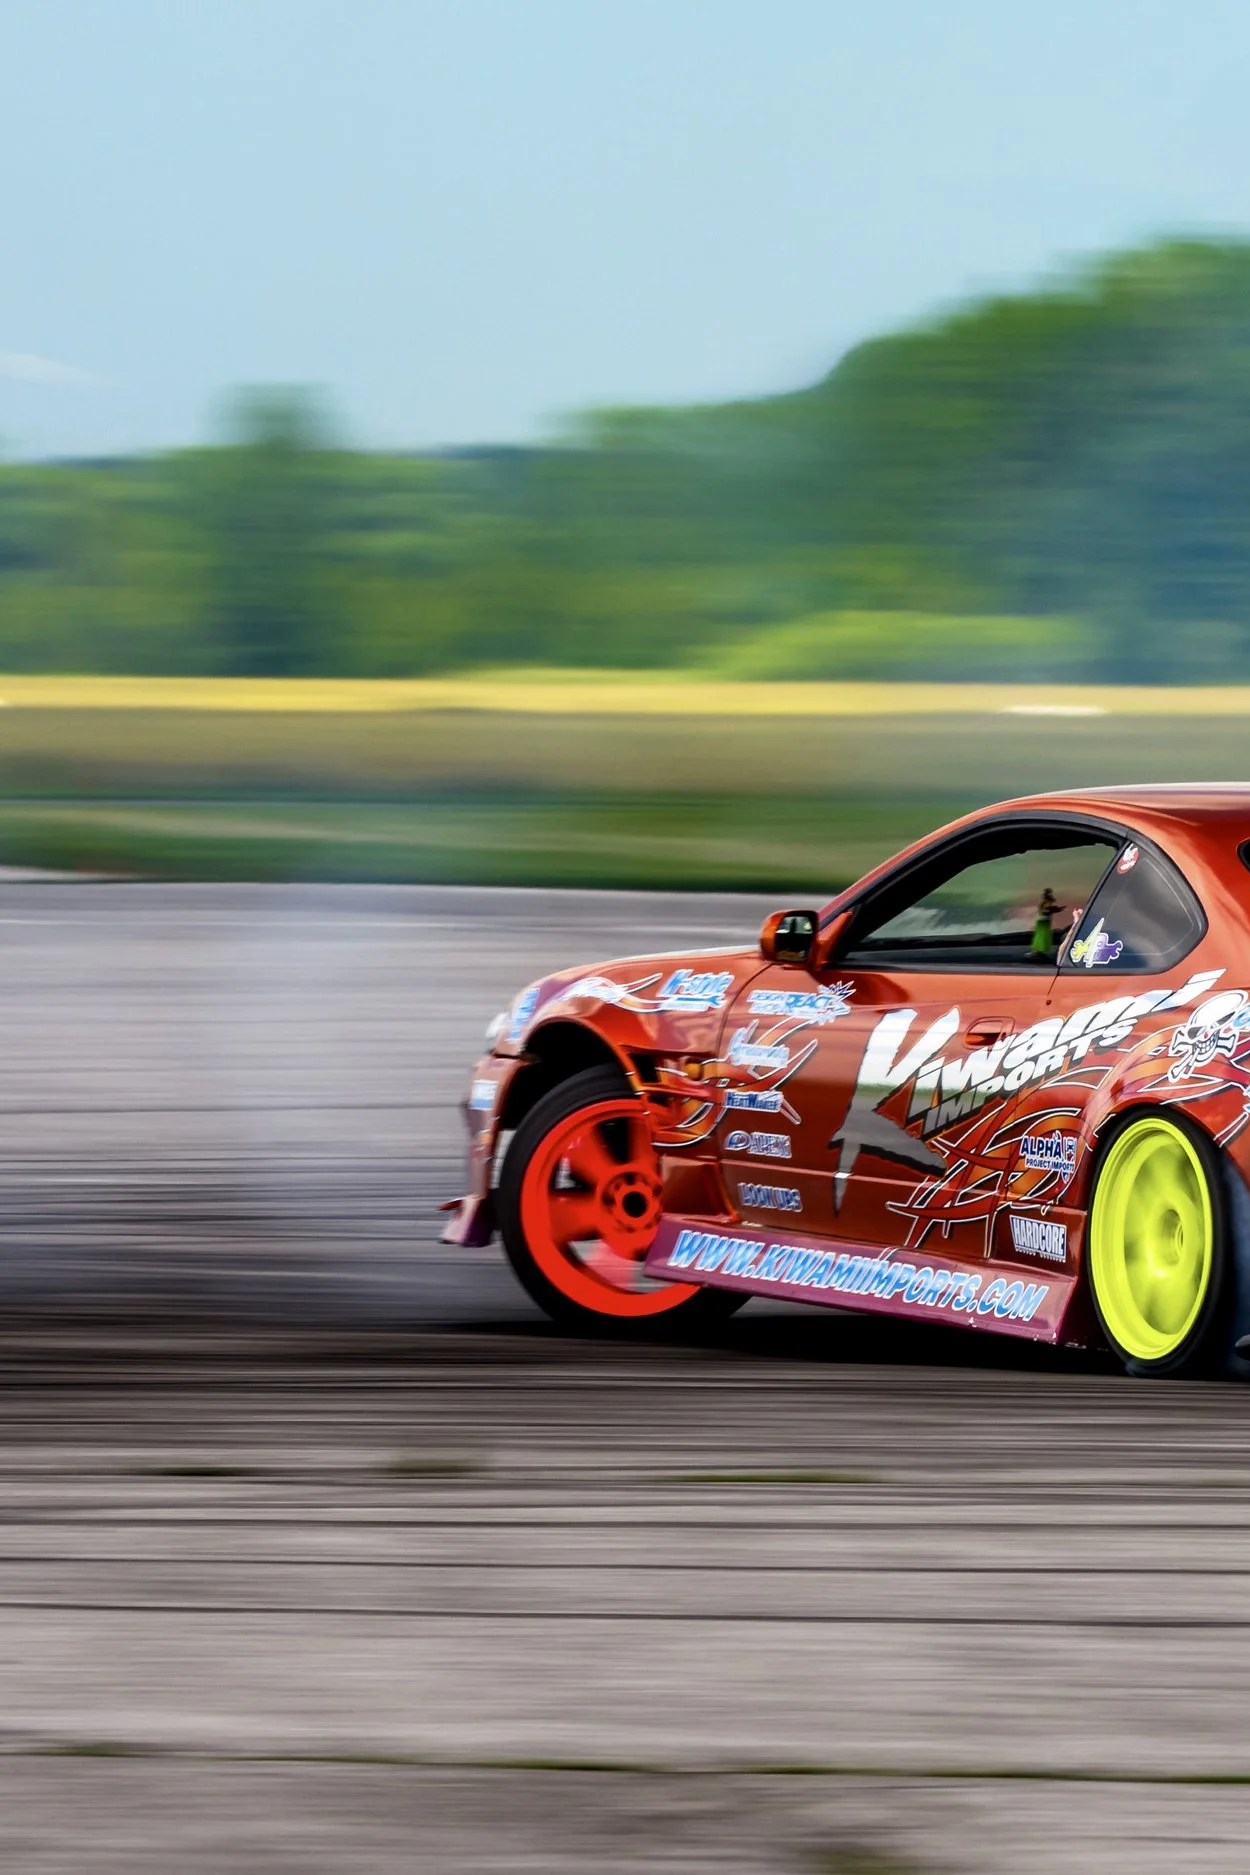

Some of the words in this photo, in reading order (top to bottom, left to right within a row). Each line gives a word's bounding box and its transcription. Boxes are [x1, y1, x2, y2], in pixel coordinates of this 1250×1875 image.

[923, 1018, 1139, 1143] IMPORTS
[1021, 1137, 1062, 1158] ALPHA
[1026, 1158, 1051, 1169] PROJECT
[1012, 1217, 1065, 1255] HARDCORE
